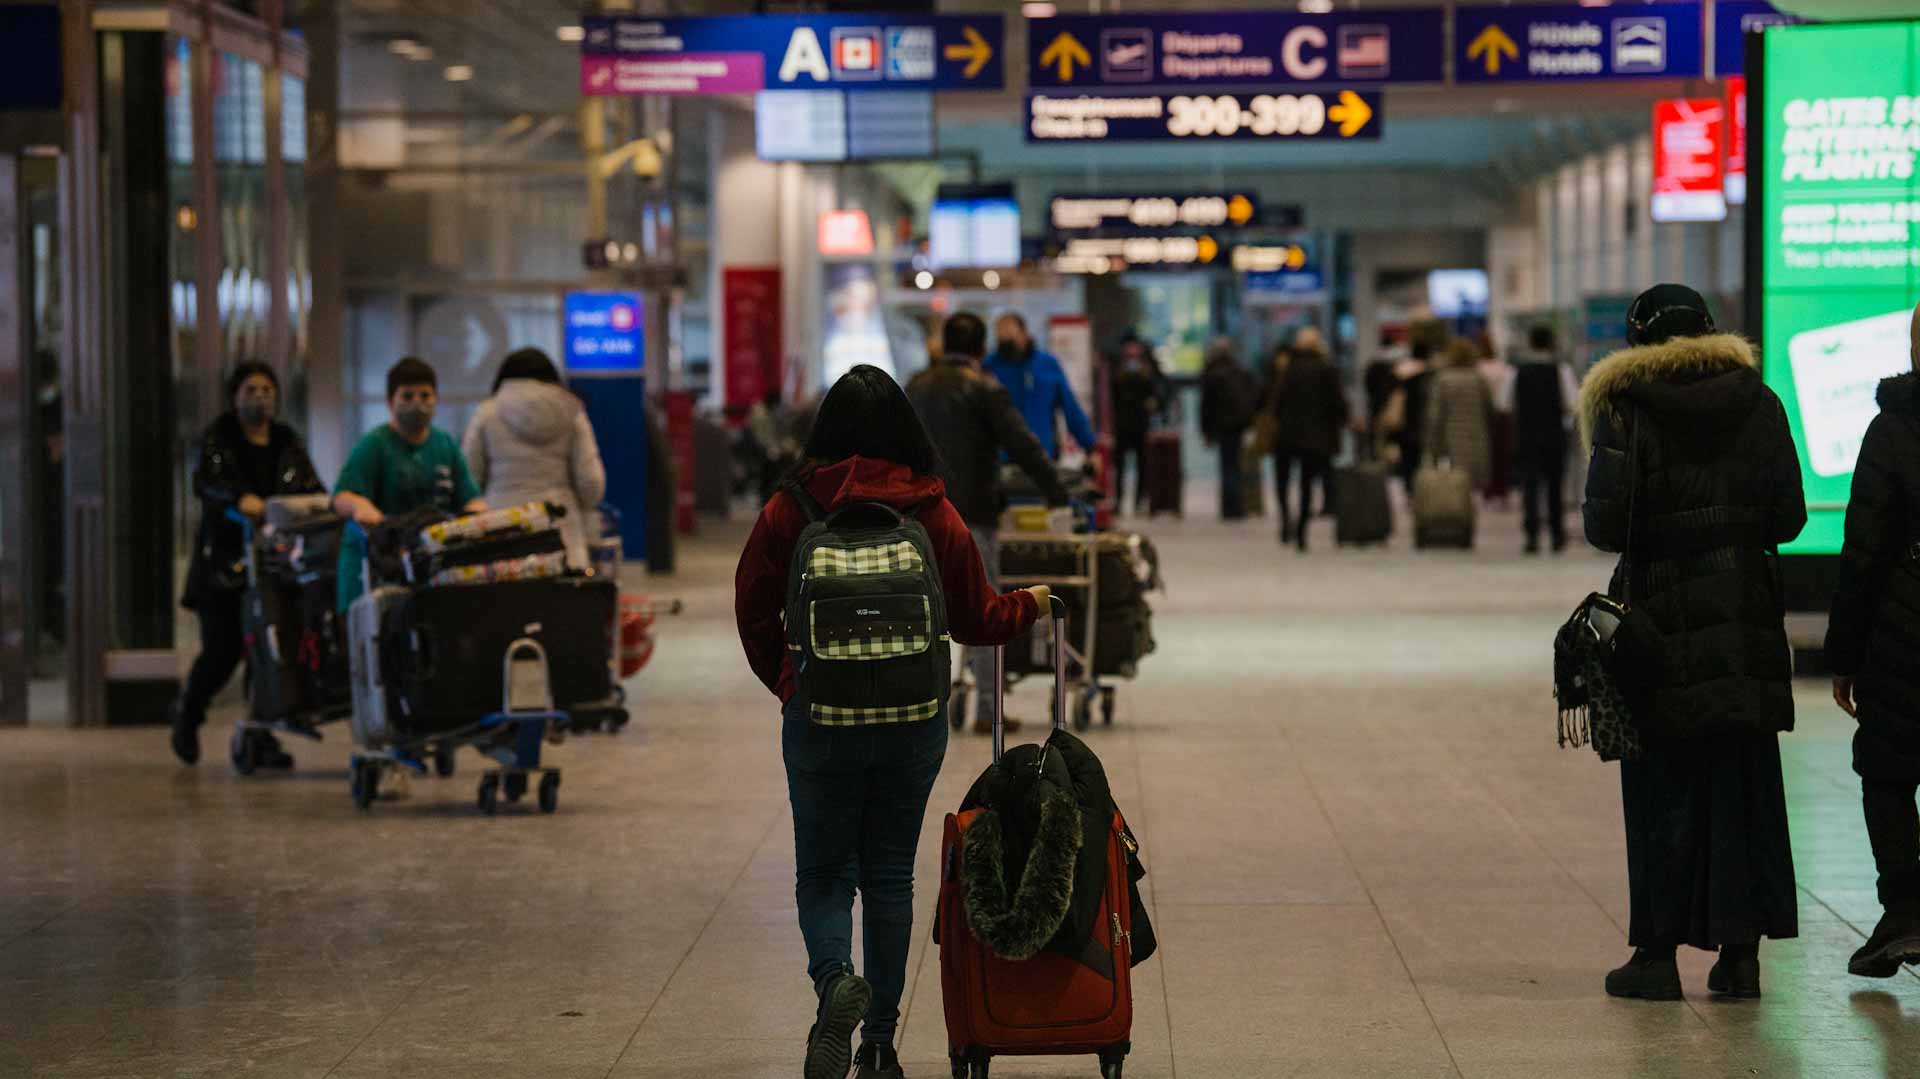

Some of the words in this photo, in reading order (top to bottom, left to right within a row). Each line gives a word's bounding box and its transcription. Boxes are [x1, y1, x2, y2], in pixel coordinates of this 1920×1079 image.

[779, 26, 829, 82] A
[1162, 56, 1273, 78] Departures
[1281, 25, 1328, 80] C
[1167, 95, 1326, 136] 300-399
[1783, 97, 1888, 126] GATES
[1782, 151, 1915, 182] FLIGHTS
[1783, 248, 1820, 268] Two
